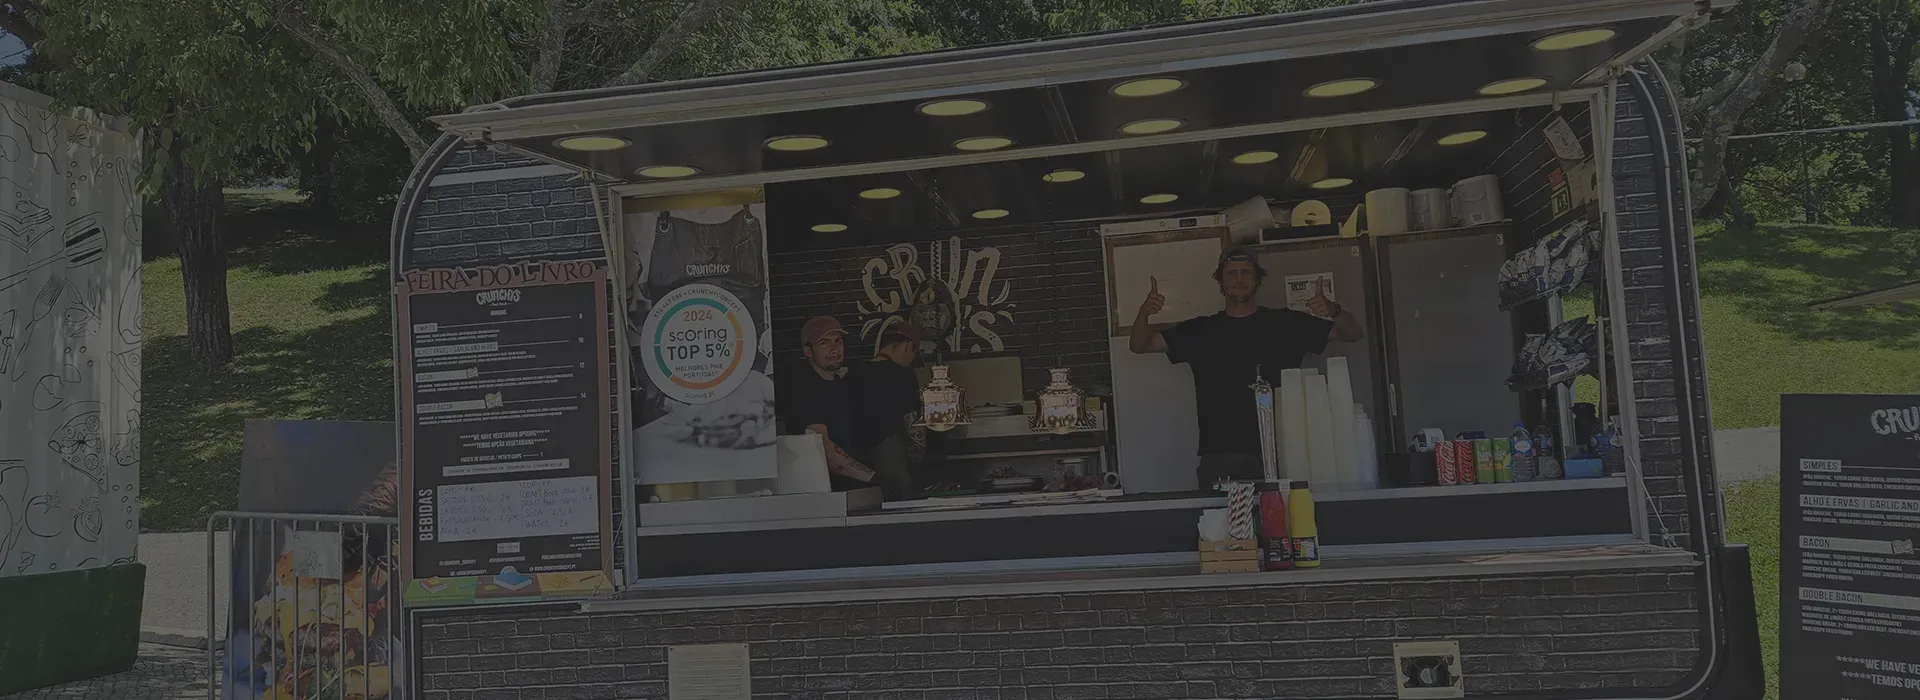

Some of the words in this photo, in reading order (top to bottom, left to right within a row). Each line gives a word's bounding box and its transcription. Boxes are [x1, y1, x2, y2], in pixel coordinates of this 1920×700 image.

[686, 263, 730, 276] CRUNCHYS
[406, 268, 470, 292] FEIRA
[479, 266, 511, 286] DO
[519, 262, 593, 283] LIVRO
[476, 289, 521, 304] CRUNCHYS
[684, 310, 712, 322] 2024
[670, 328, 727, 342] scoring
[667, 345, 700, 360] TOP
[1440, 441, 1457, 484] Coca-Cola
[1804, 461, 1838, 470] SIMPLES
[1803, 497, 1824, 506] ALHO
[1826, 498, 1830, 506] E
[1833, 498, 1859, 507] ERVAS
[1870, 500, 1899, 510] GARLIC
[1901, 501, 1918, 510] AND
[419, 488, 433, 541] BEBIDAS
[1804, 538, 1830, 547] BACON
[1803, 590, 1833, 600] DOUBLE
[1836, 593, 1863, 603] BACON
[1882, 660, 1907, 673] HAVE
